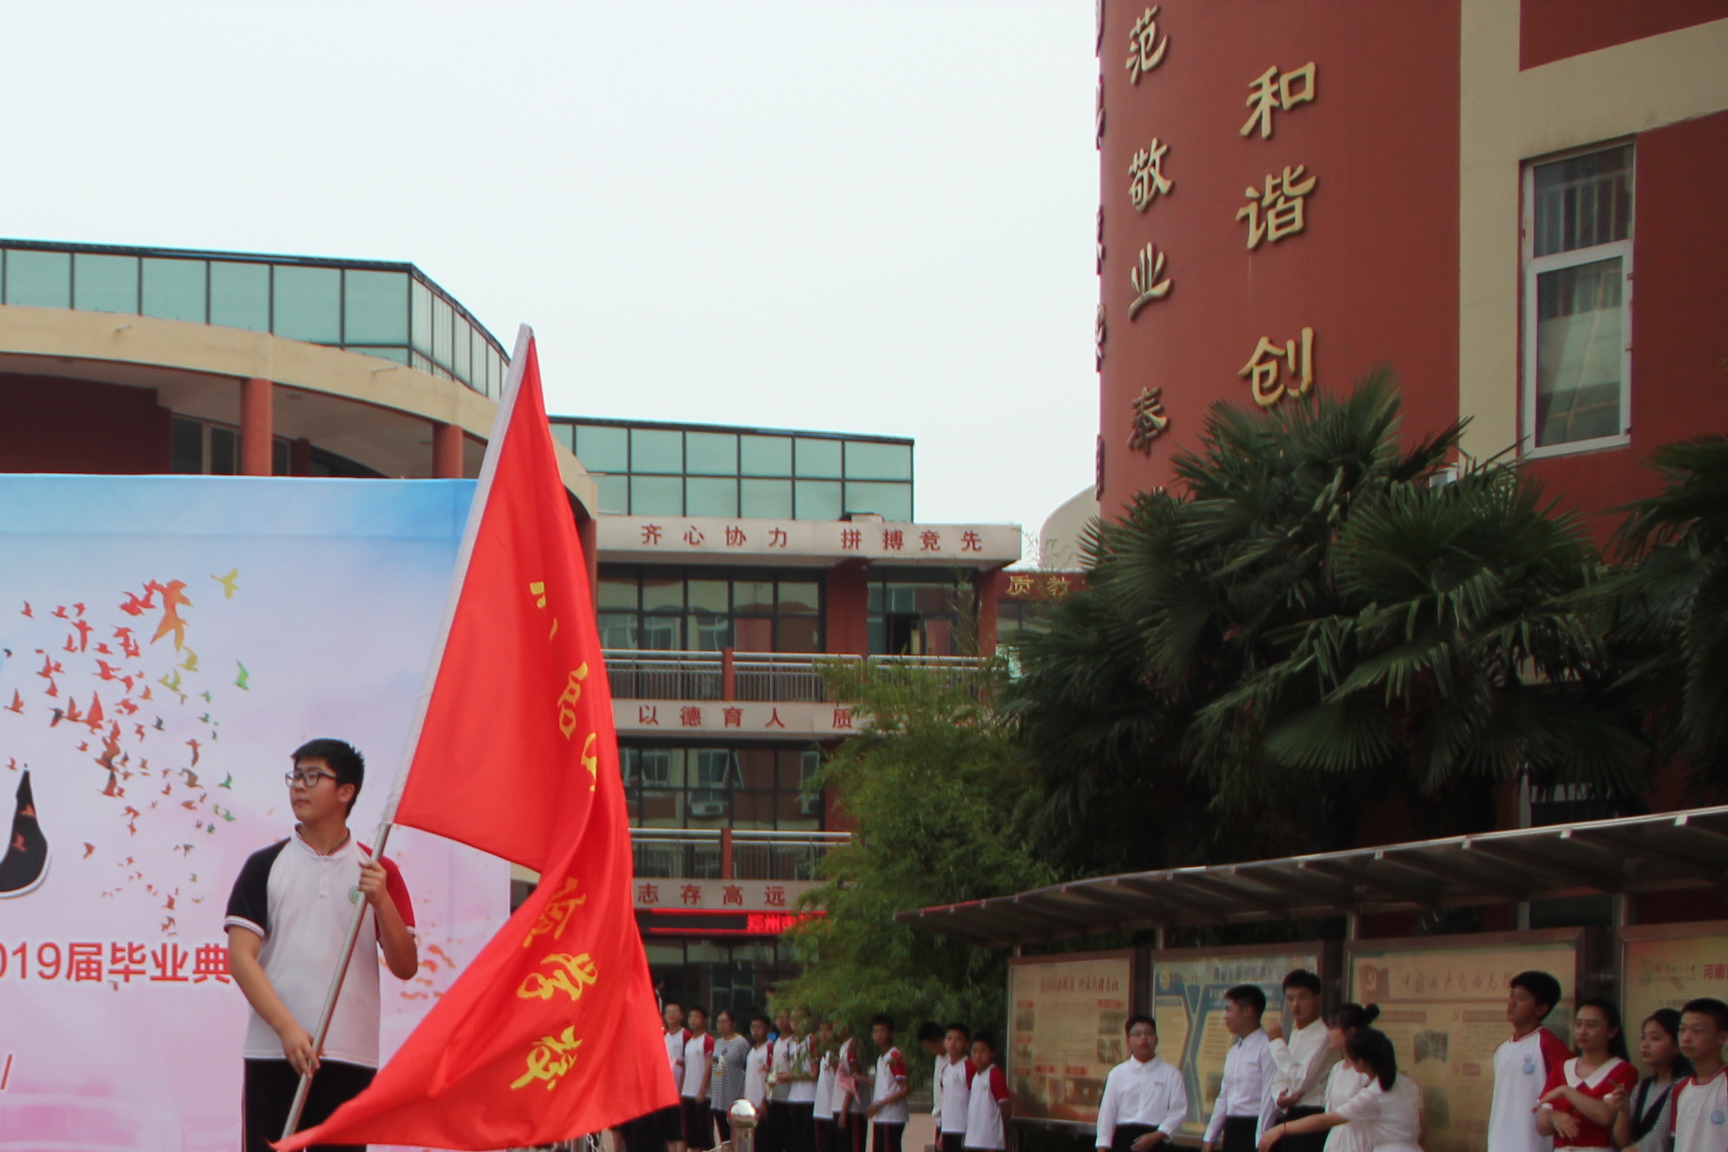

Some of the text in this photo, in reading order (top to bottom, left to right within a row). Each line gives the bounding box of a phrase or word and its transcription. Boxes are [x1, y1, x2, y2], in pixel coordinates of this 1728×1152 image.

[1125, 386, 1170, 480] 奉
[640, 523, 789, 550] 齐心协力
[638, 704, 786, 729] 以德育人
[637, 882, 786, 907] 志存高远
